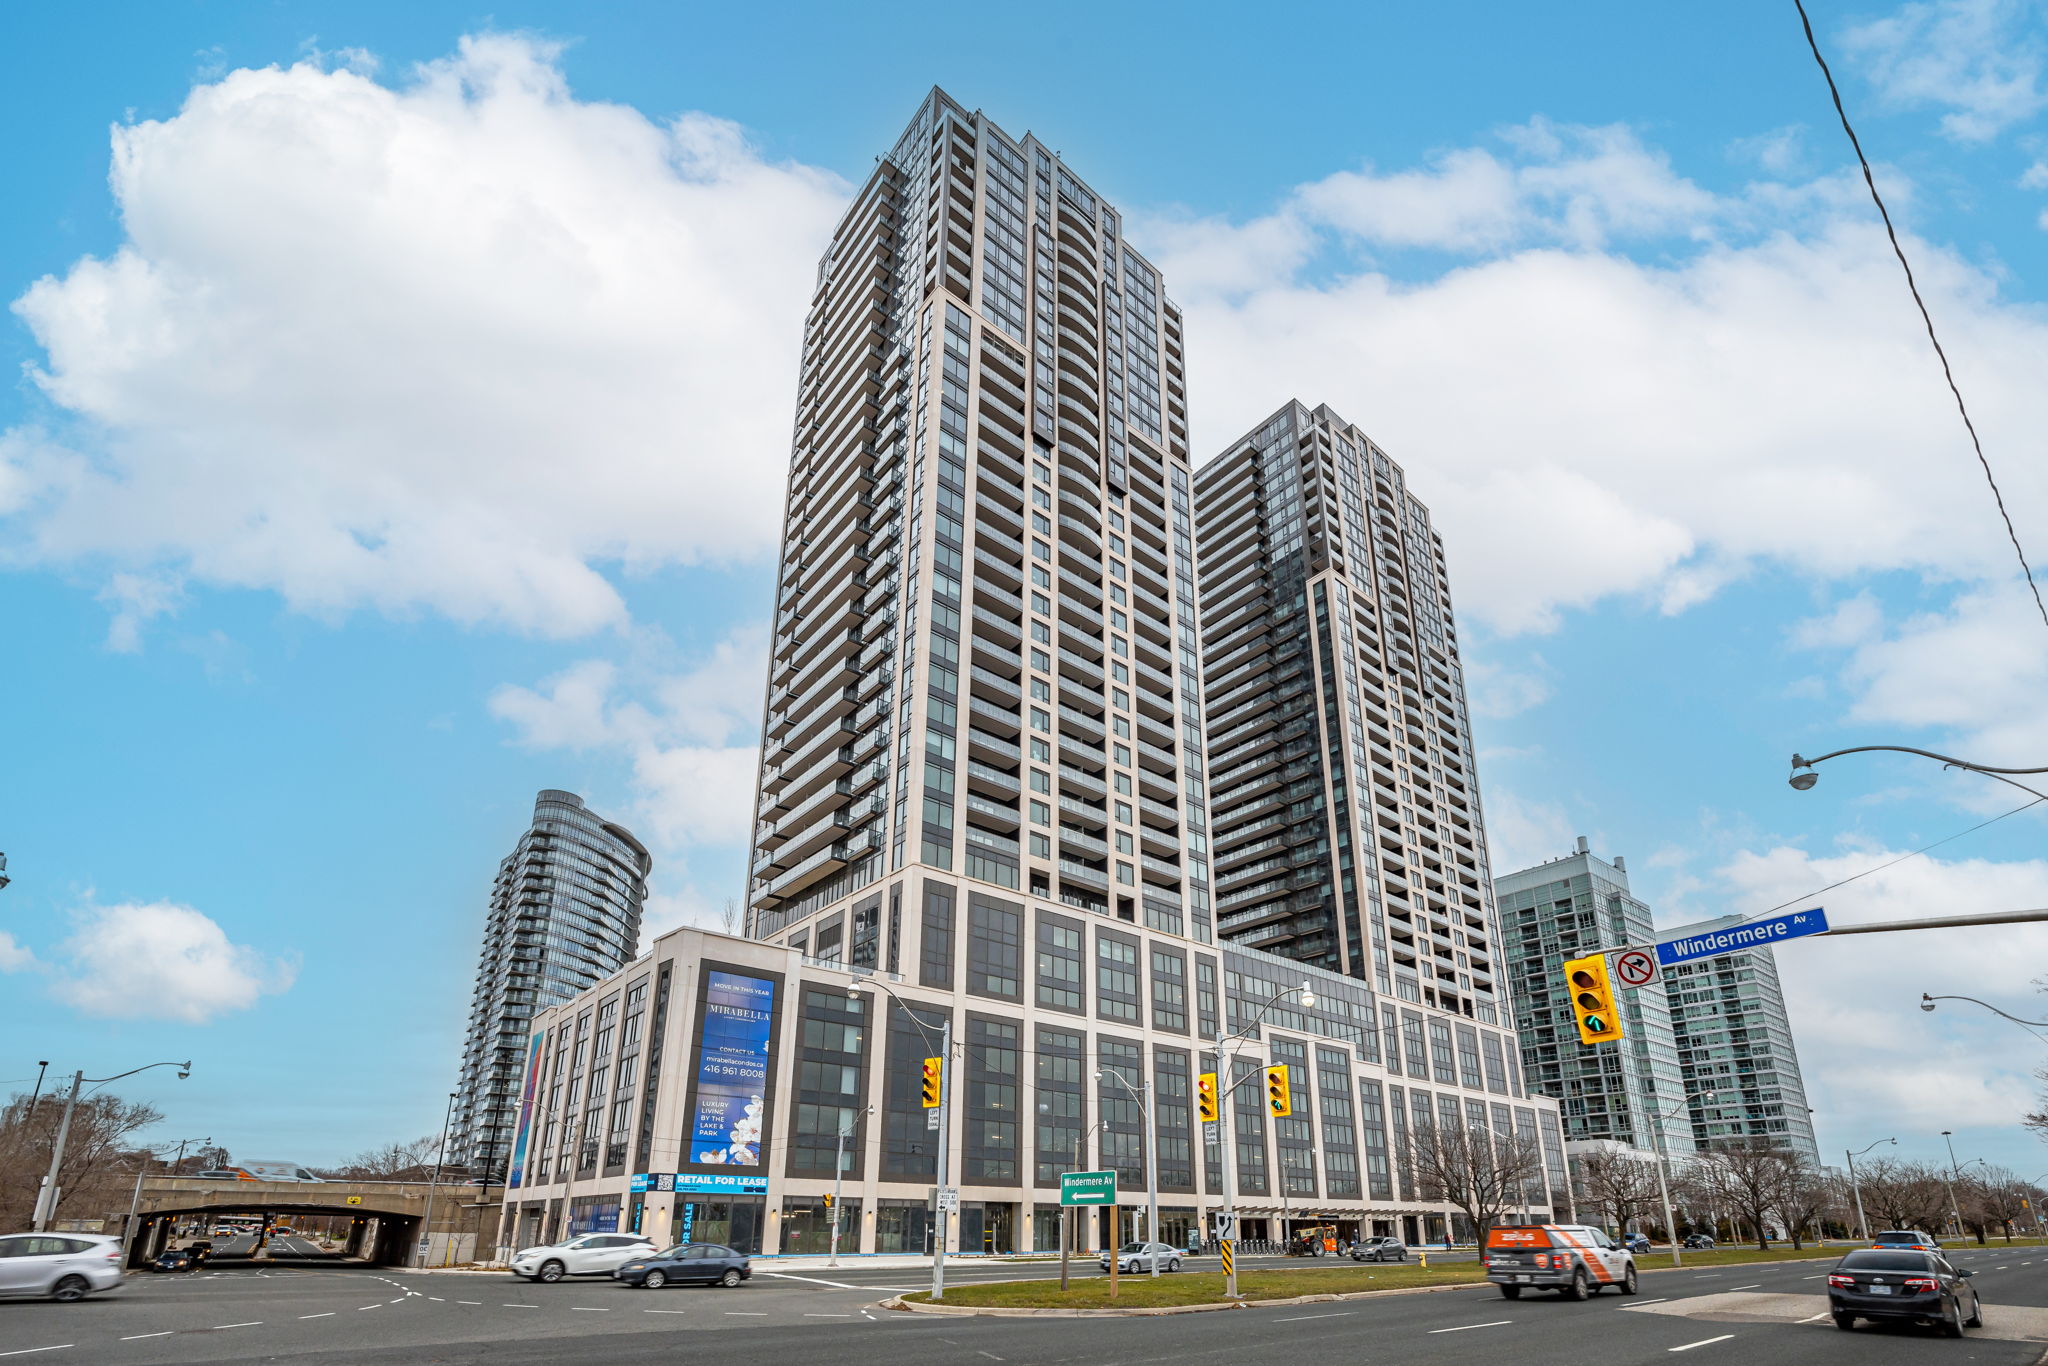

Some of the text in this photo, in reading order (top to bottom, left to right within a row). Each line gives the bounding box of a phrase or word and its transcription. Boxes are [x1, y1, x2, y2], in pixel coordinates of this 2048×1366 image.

[1672, 915, 1806, 957] Windermere Av
[714, 982, 732, 990] MOVE
[741, 986, 754, 994] THIS
[710, 1004, 770, 1021] MIRABELLA
[719, 1046, 746, 1054] CONTACT
[706, 1056, 764, 1068] mirabellacondos.ca
[704, 1065, 764, 1078] 416 961 8008
[677, 1175, 767, 1186] RETAIL FOR LEASE
[1064, 1176, 1113, 1187] Windermere Av
[683, 1203, 694, 1230] SALE
